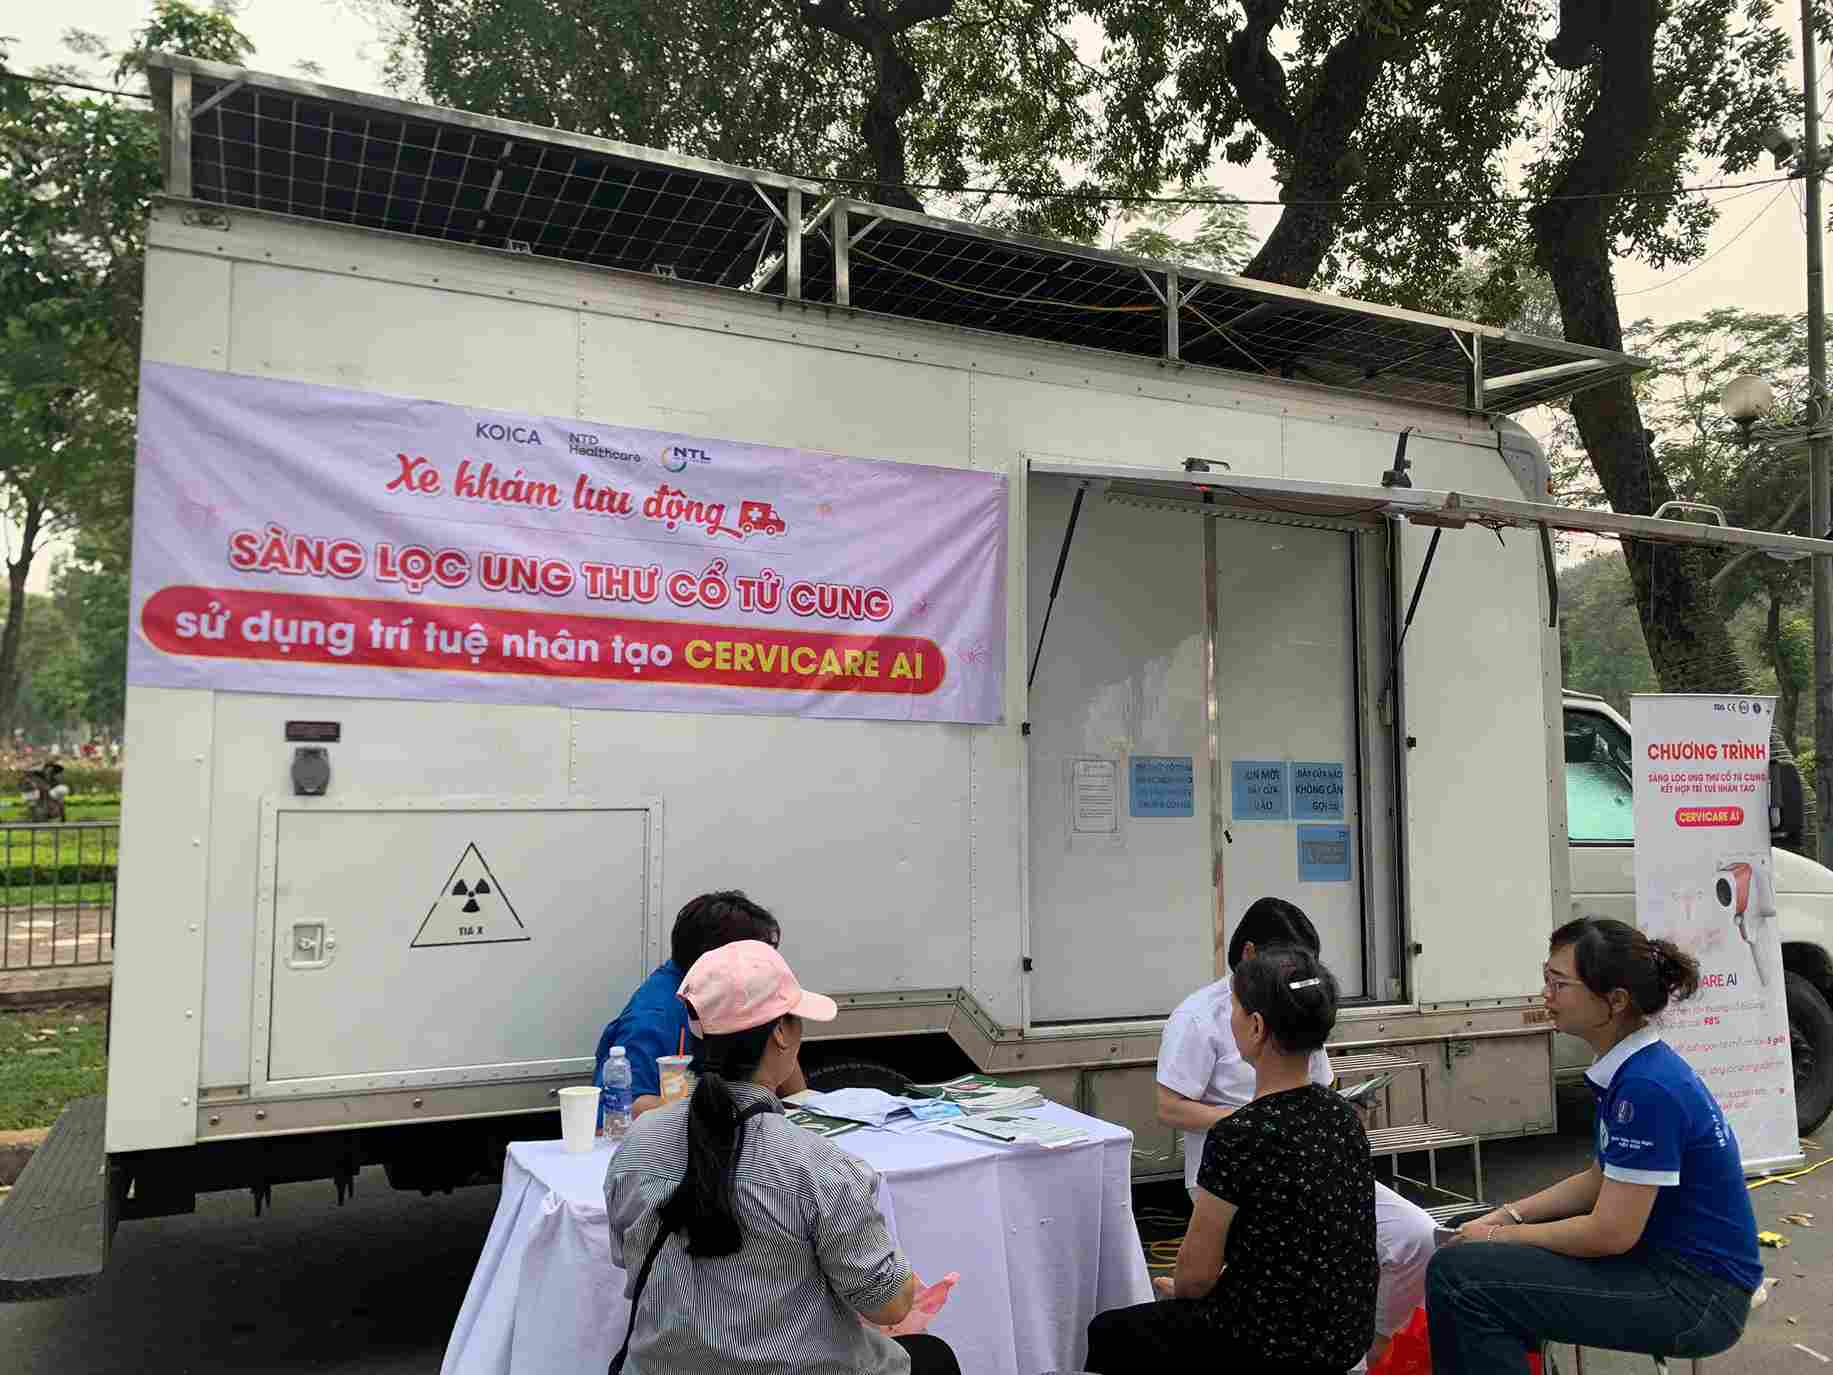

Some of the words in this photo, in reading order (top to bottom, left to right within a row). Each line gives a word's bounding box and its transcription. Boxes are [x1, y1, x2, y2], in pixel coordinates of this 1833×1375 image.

[476, 423, 542, 445] KOICA
[569, 433, 599, 446] NTD
[569, 444, 641, 463] Healthcare
[674, 447, 711, 461] NTL
[386, 452, 441, 493] Xe
[454, 459, 561, 508] khám
[572, 473, 633, 515] lưu
[643, 482, 744, 540] động
[230, 526, 365, 580] SÀNG
[374, 543, 470, 593] LỌC
[479, 552, 577, 597] UNG
[583, 562, 660, 603] THƯ
[667, 558, 730, 608] CỔ
[737, 569, 783, 613] TỬ
[789, 582, 893, 622] CUNG
[175, 602, 232, 641] sử
[241, 611, 356, 656] dụng
[370, 617, 414, 652] trí
[423, 622, 489, 664] tuệ
[502, 630, 598, 662] nhân
[611, 635, 673, 673] tạo
[684, 639, 880, 678] CERVICARE
[890, 652, 923, 680] AI
[1648, 740, 1718, 760] CHƯƠNG
[1721, 738, 1766, 760] TRÌNH
[1680, 811, 1728, 823] CERVICARE
[459, 927, 474, 936] TIA
